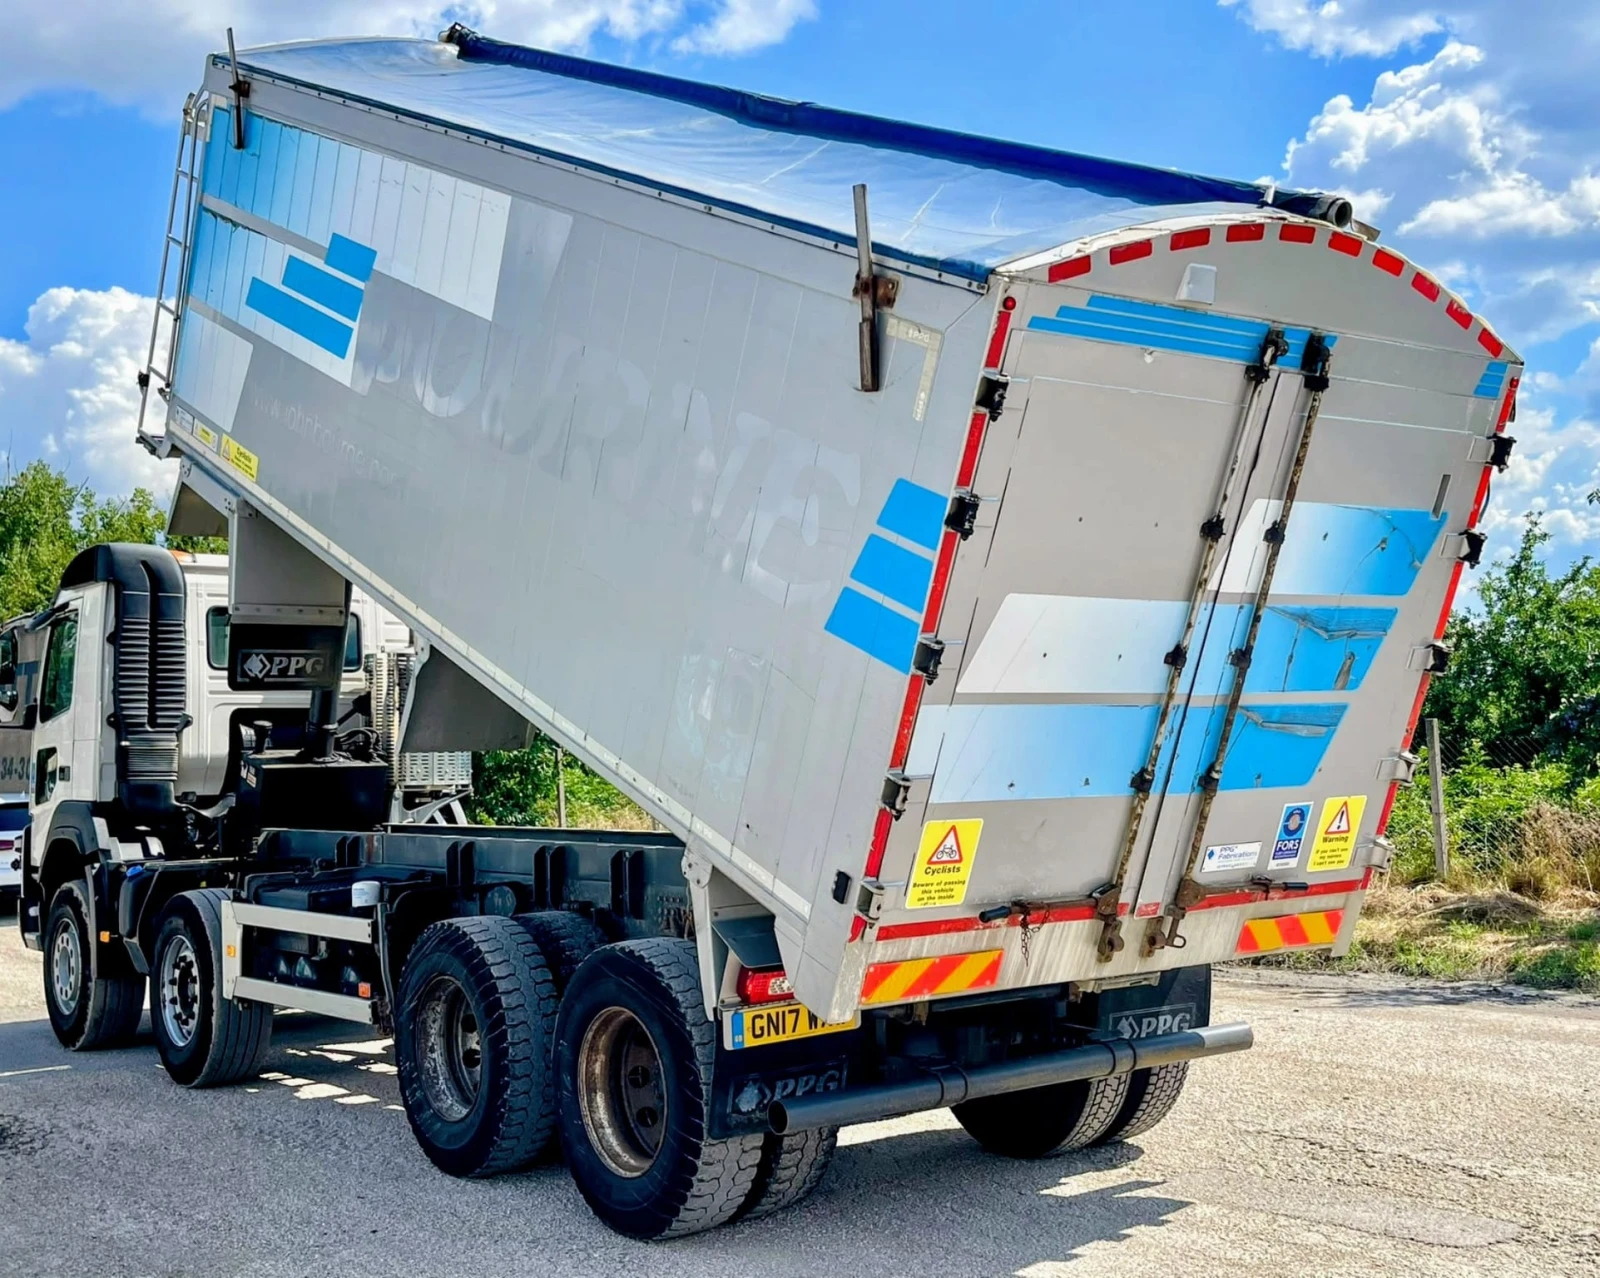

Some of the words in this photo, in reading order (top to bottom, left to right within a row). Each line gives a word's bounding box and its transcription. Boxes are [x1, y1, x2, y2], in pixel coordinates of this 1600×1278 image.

[269, 656, 325, 676] PPG
[1276, 840, 1300, 851] FORS
[1322, 836, 1349, 844] Warning
[924, 865, 961, 876] Cyclists
[751, 1008, 800, 1039] GN17
[1140, 1012, 1191, 1038] PPG
[773, 1070, 840, 1101] PPG
